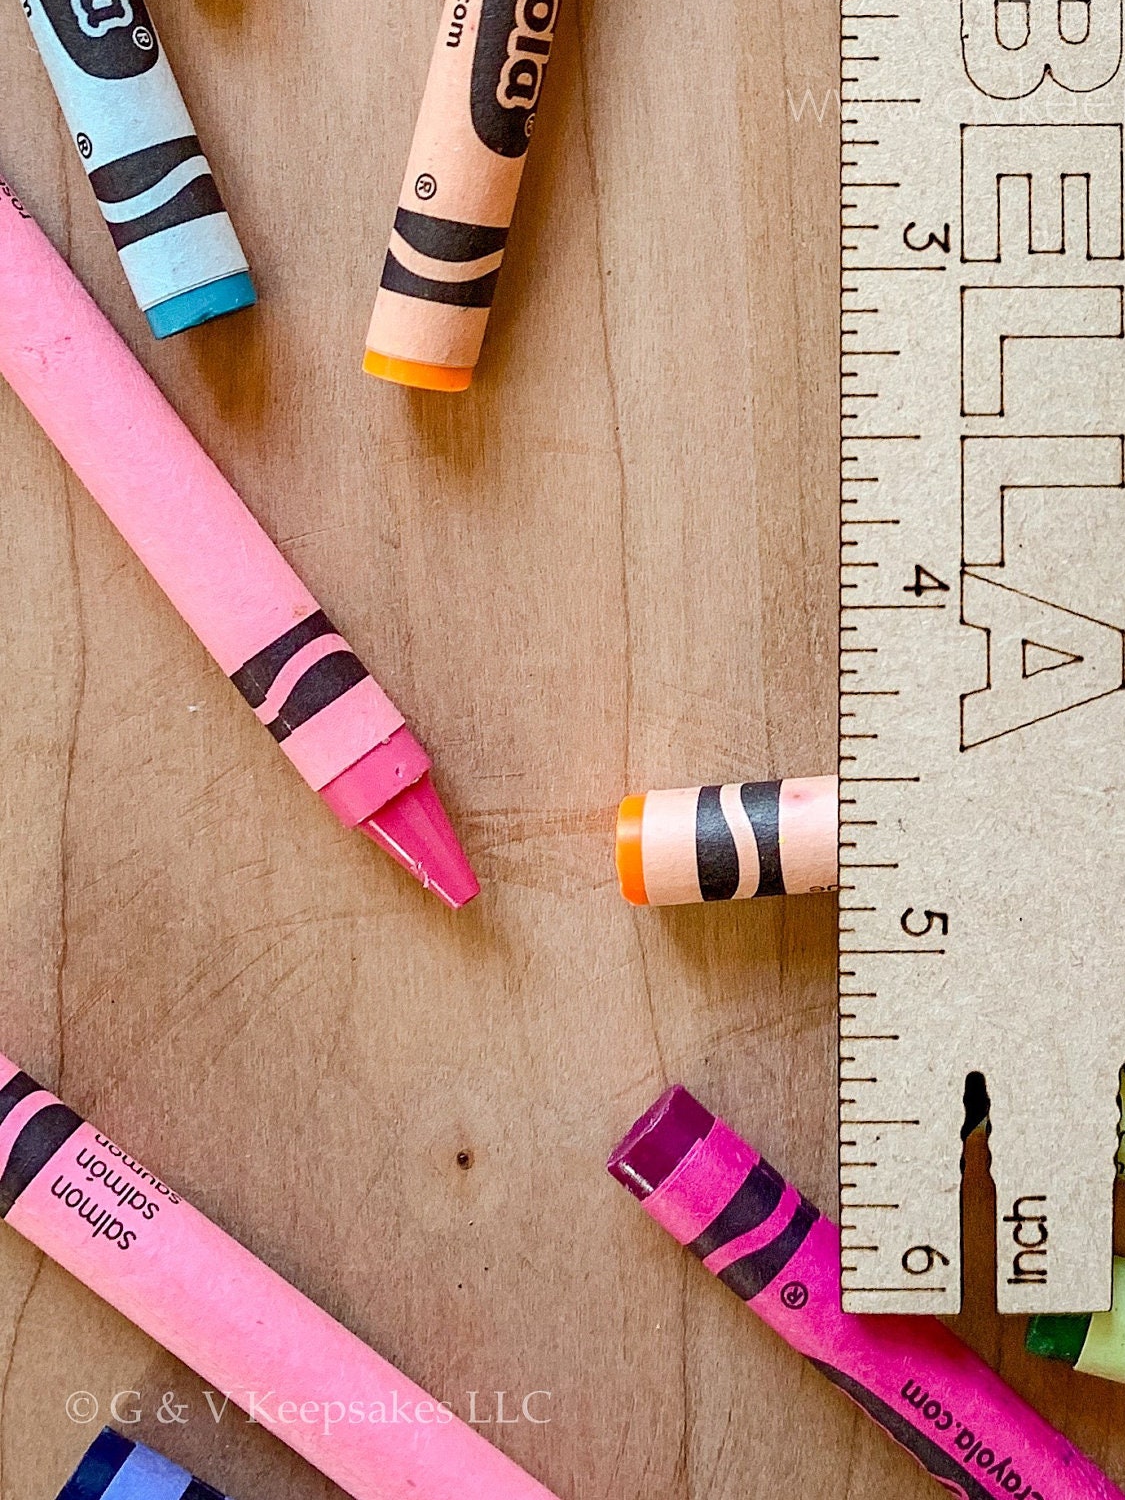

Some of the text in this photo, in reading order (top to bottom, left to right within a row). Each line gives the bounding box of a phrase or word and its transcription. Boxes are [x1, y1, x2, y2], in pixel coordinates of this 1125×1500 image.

[903, 221, 951, 254] 3
[903, 563, 951, 597] 4
[901, 907, 949, 937] 5
[76, 1147, 160, 1220] salmón
[94, 1133, 182, 1205] saumon
[51, 1174, 137, 1250] salmon
[902, 1245, 950, 1276] 6
[1003, 1195, 1048, 1285] Inch
